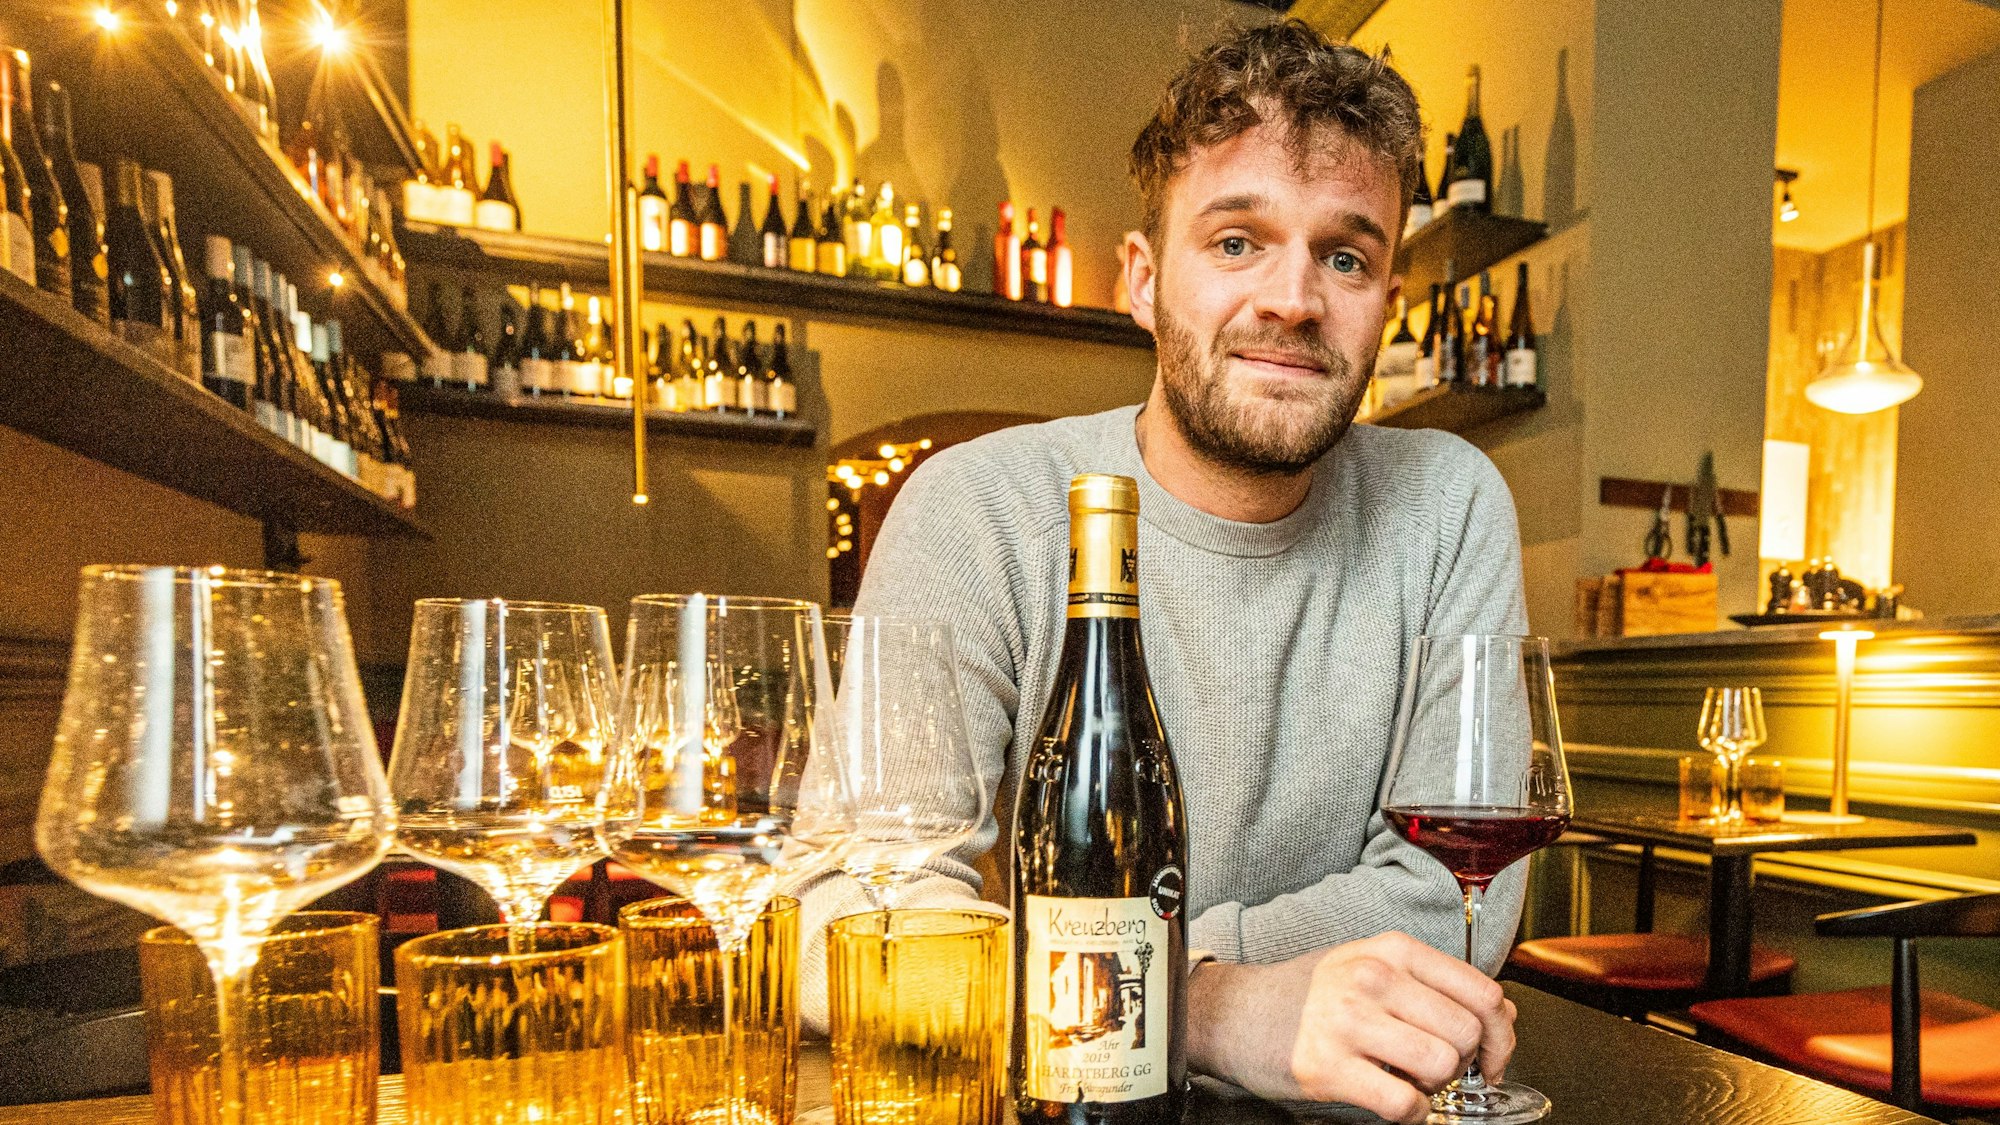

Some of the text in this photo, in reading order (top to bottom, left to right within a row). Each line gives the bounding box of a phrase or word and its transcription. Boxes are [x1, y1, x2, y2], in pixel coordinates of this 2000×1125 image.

[1049, 907, 1147, 945] Kreuzberg
[1098, 1040, 1120, 1051] Ahr
[1082, 1052, 1111, 1064] 2019
[1133, 1062, 1152, 1077] GG
